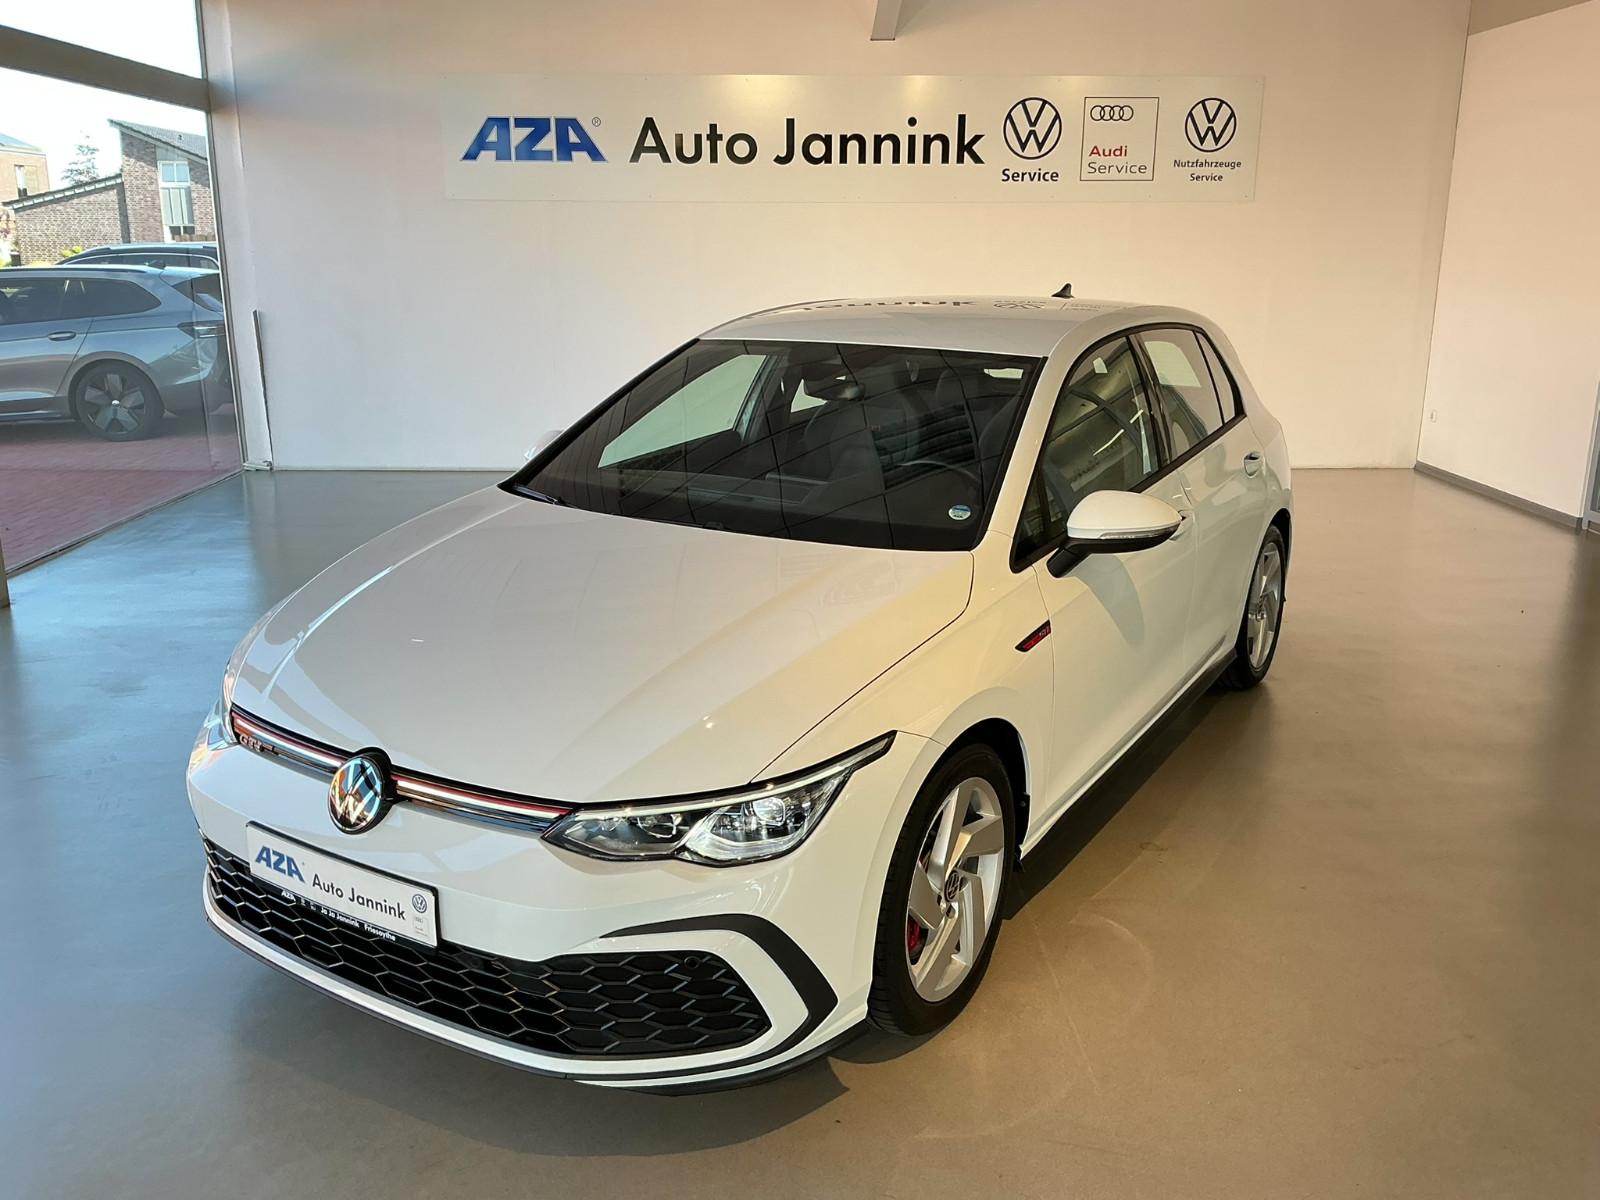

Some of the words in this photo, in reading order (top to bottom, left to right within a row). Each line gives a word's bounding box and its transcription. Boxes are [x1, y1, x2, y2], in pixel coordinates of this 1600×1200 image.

[461, 116, 608, 162] AZA
[629, 116, 758, 165] Auto
[773, 113, 986, 166] Jannink
[1088, 144, 1129, 158] Audi
[1087, 161, 1149, 175] Service
[1172, 158, 1243, 170] Nutzfahrzeuge
[1001, 167, 1060, 183] Service
[1189, 172, 1224, 182] Service
[255, 845, 306, 884] AZA
[312, 873, 344, 899] Auto
[348, 887, 407, 922] Jannink
